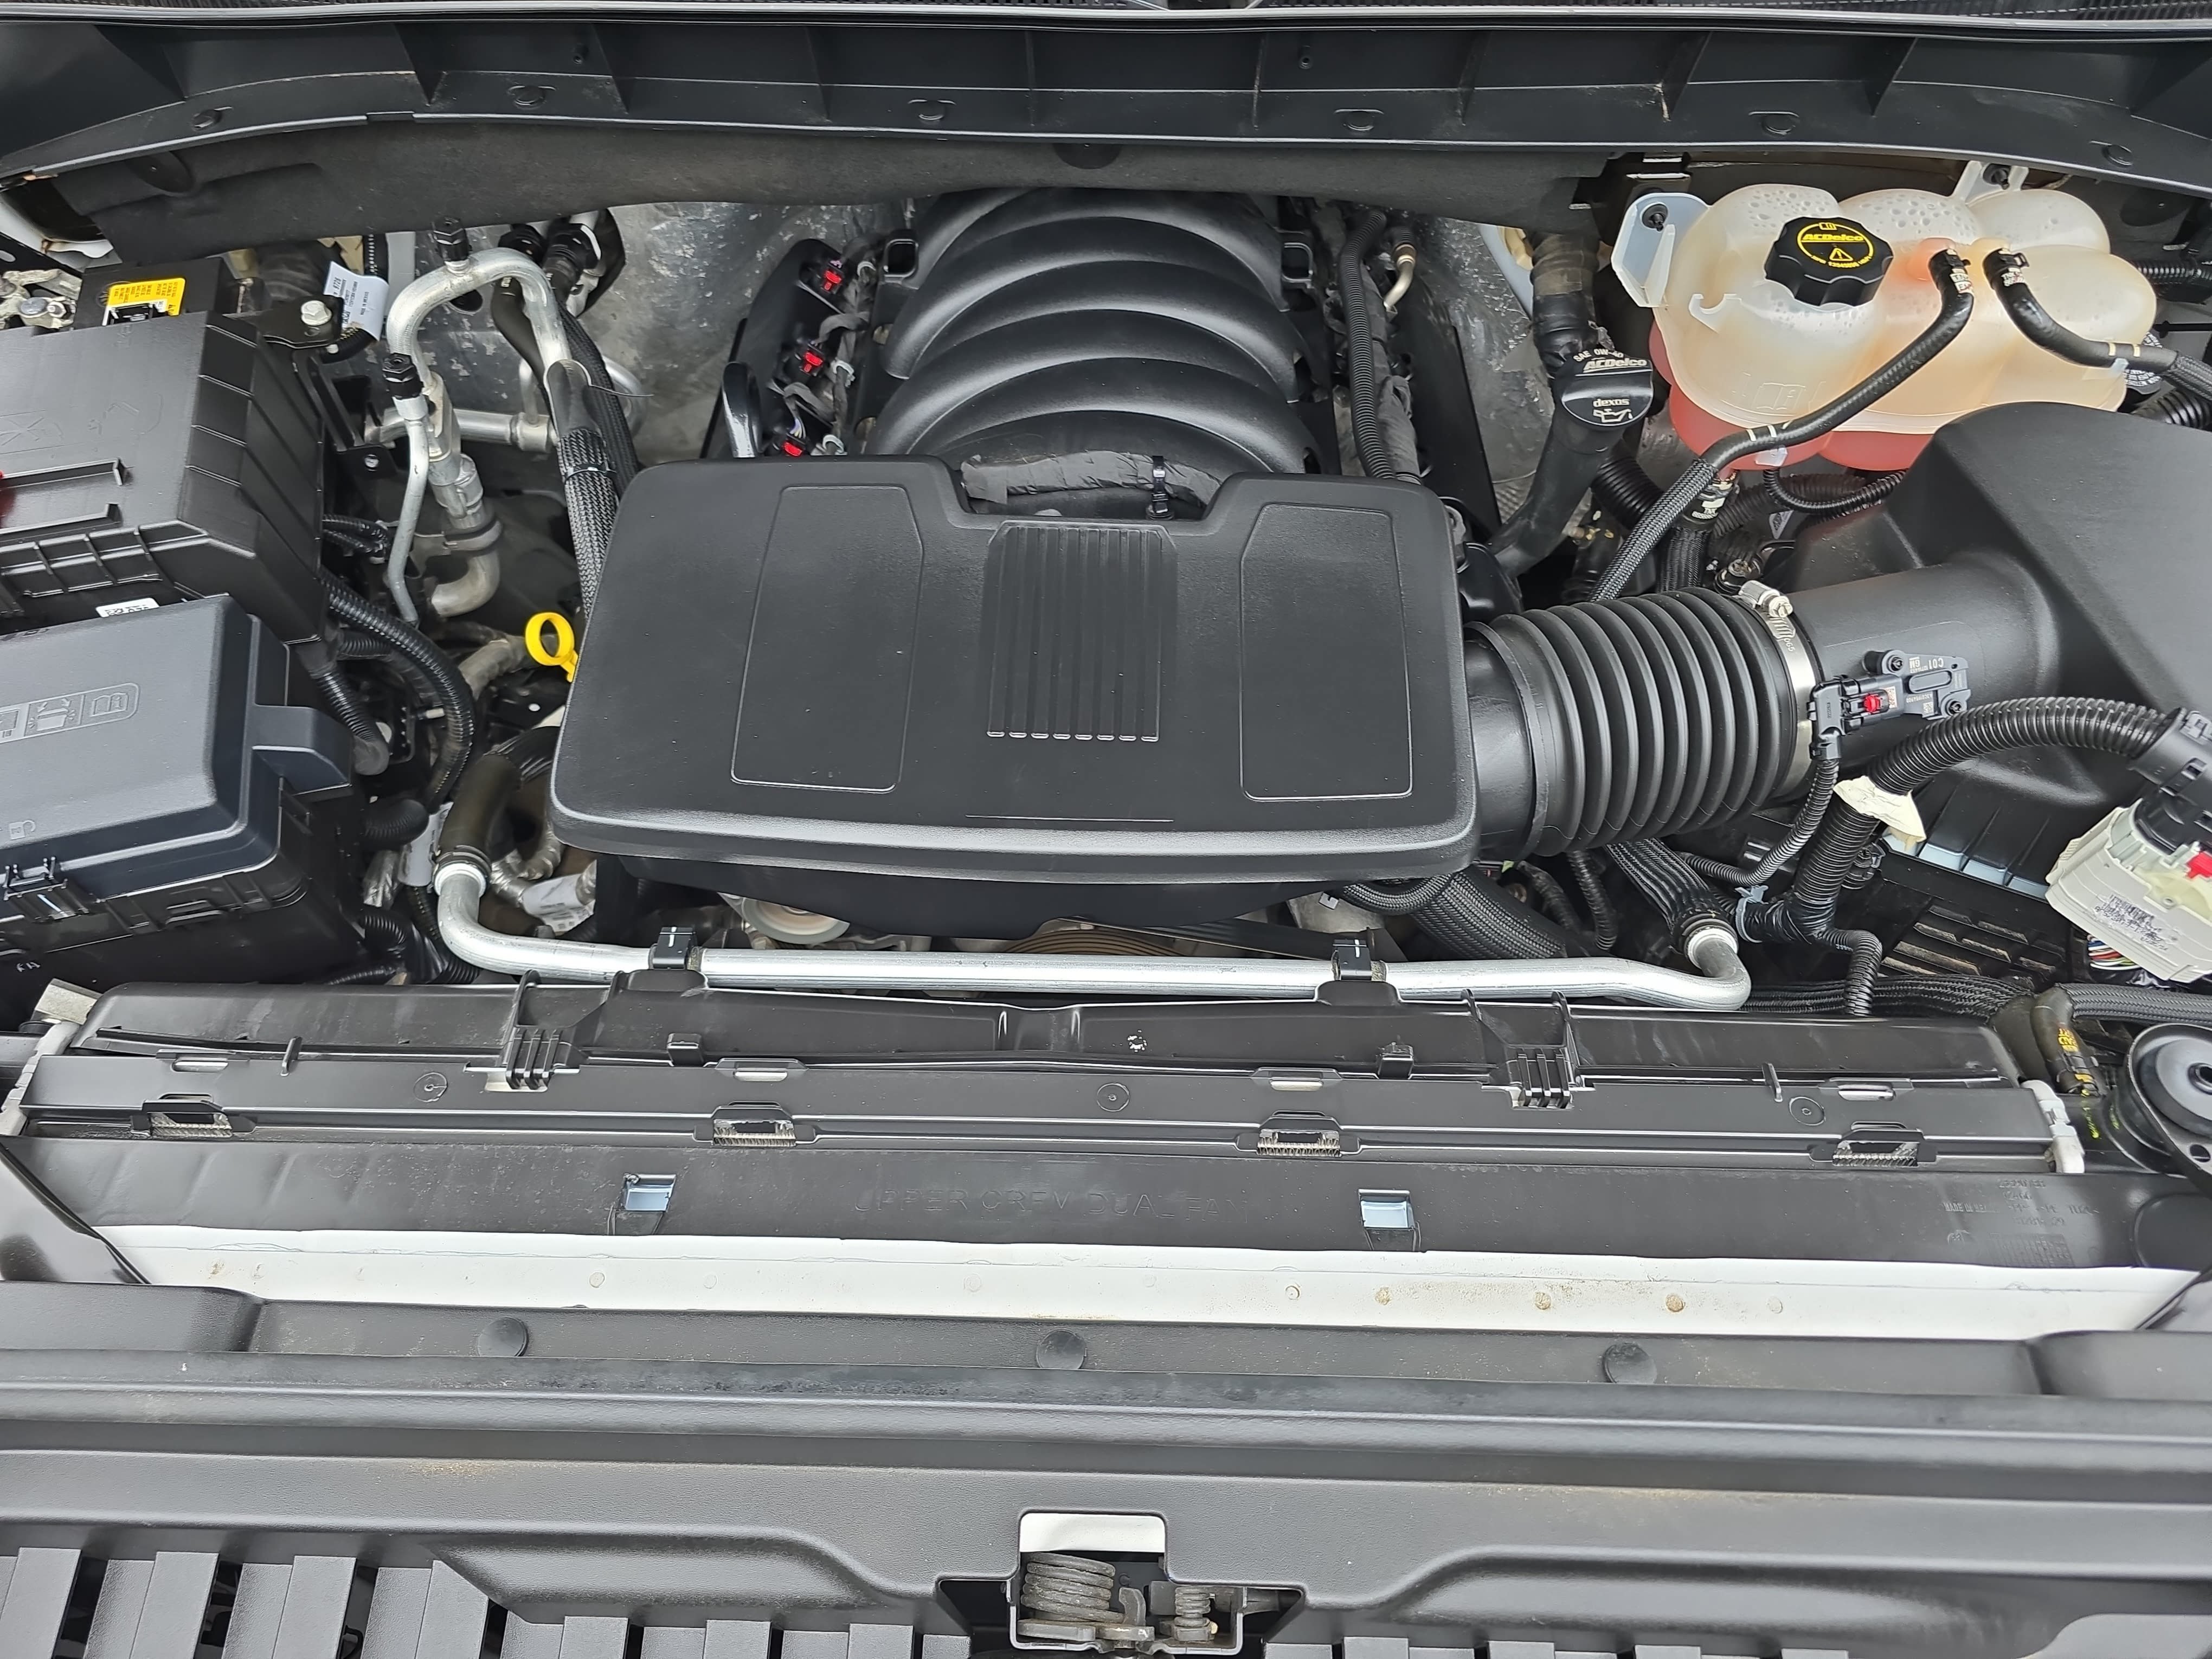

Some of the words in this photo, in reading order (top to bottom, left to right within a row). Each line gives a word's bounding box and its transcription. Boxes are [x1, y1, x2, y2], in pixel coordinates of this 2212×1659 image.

[1573, 350, 1592, 362] SAE
[1583, 358, 1648, 371] ACDelco
[1593, 398, 1630, 408] dexos
[1909, 658, 1920, 668] GM
[853, 1188, 968, 1211] UPPER
[1943, 1201, 1964, 1212] MADE
